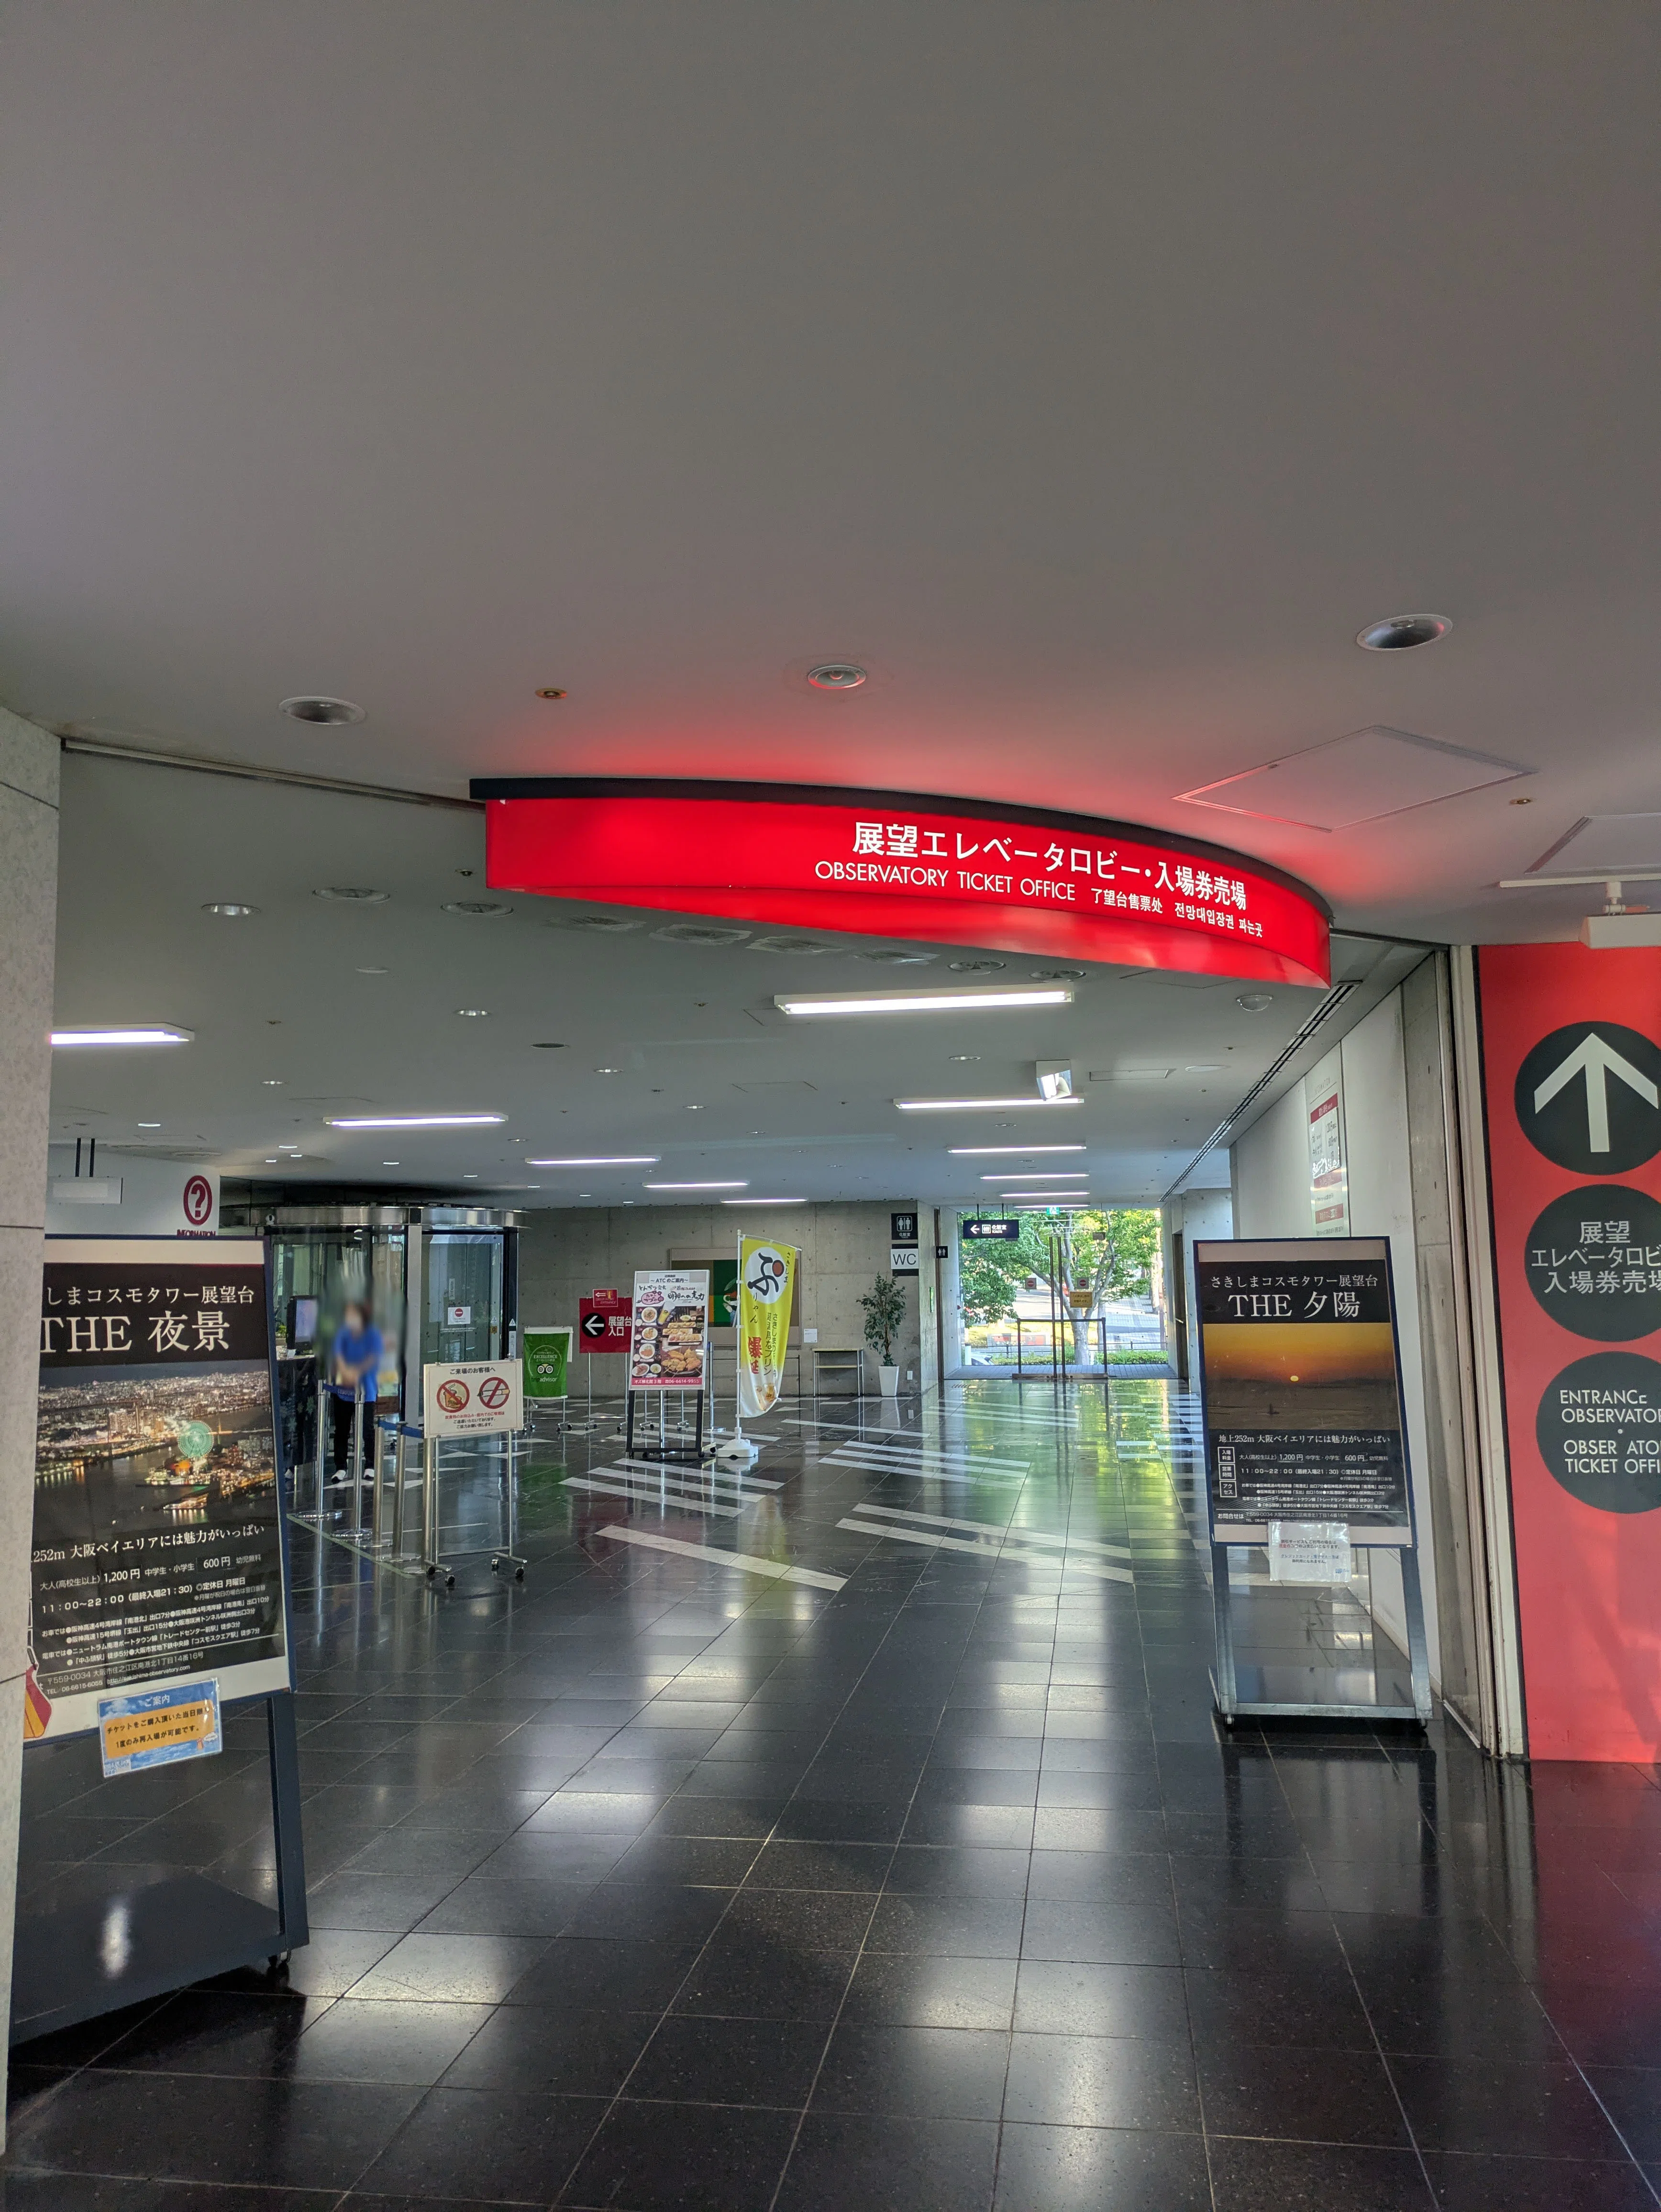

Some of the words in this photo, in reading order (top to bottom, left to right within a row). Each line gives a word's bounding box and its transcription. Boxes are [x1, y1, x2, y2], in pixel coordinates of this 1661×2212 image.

[853, 821, 1247, 911] 展望エレベータロビー・入場券売場
[815, 861, 949, 887] OBSERVATORY
[957, 871, 1013, 894] TICKET
[1020, 878, 1076, 901] OFFICE
[1091, 887, 1163, 914] 了望台售票处
[1174, 901, 1235, 930] 전망대입장권
[1239, 918, 1263, 938] 파는곳
[1579, 1220, 1631, 1244] 展望
[893, 1253, 917, 1265] WC
[1211, 1274, 1378, 1288] さきしまコスモタワー展望台
[1228, 1294, 1293, 1317] THE
[1304, 1291, 1361, 1318] 夕陽
[608, 1316, 632, 1327] 展望台
[40, 1316, 133, 1353] THE
[147, 1310, 231, 1353] 夜景
[608, 1327, 624, 1336] 入口
[450, 1366, 496, 1375] ご来場のお客様へ
[1561, 1408, 1661, 1424] OBSERVATO
[1218, 1434, 1254, 1443] 地上252m
[1565, 1459, 1618, 1473] TICKET
[31, 1548, 66, 1563] 252m
[225, 1577, 245, 1587] 月曜日
[144, 1694, 170, 1707] ご案内
